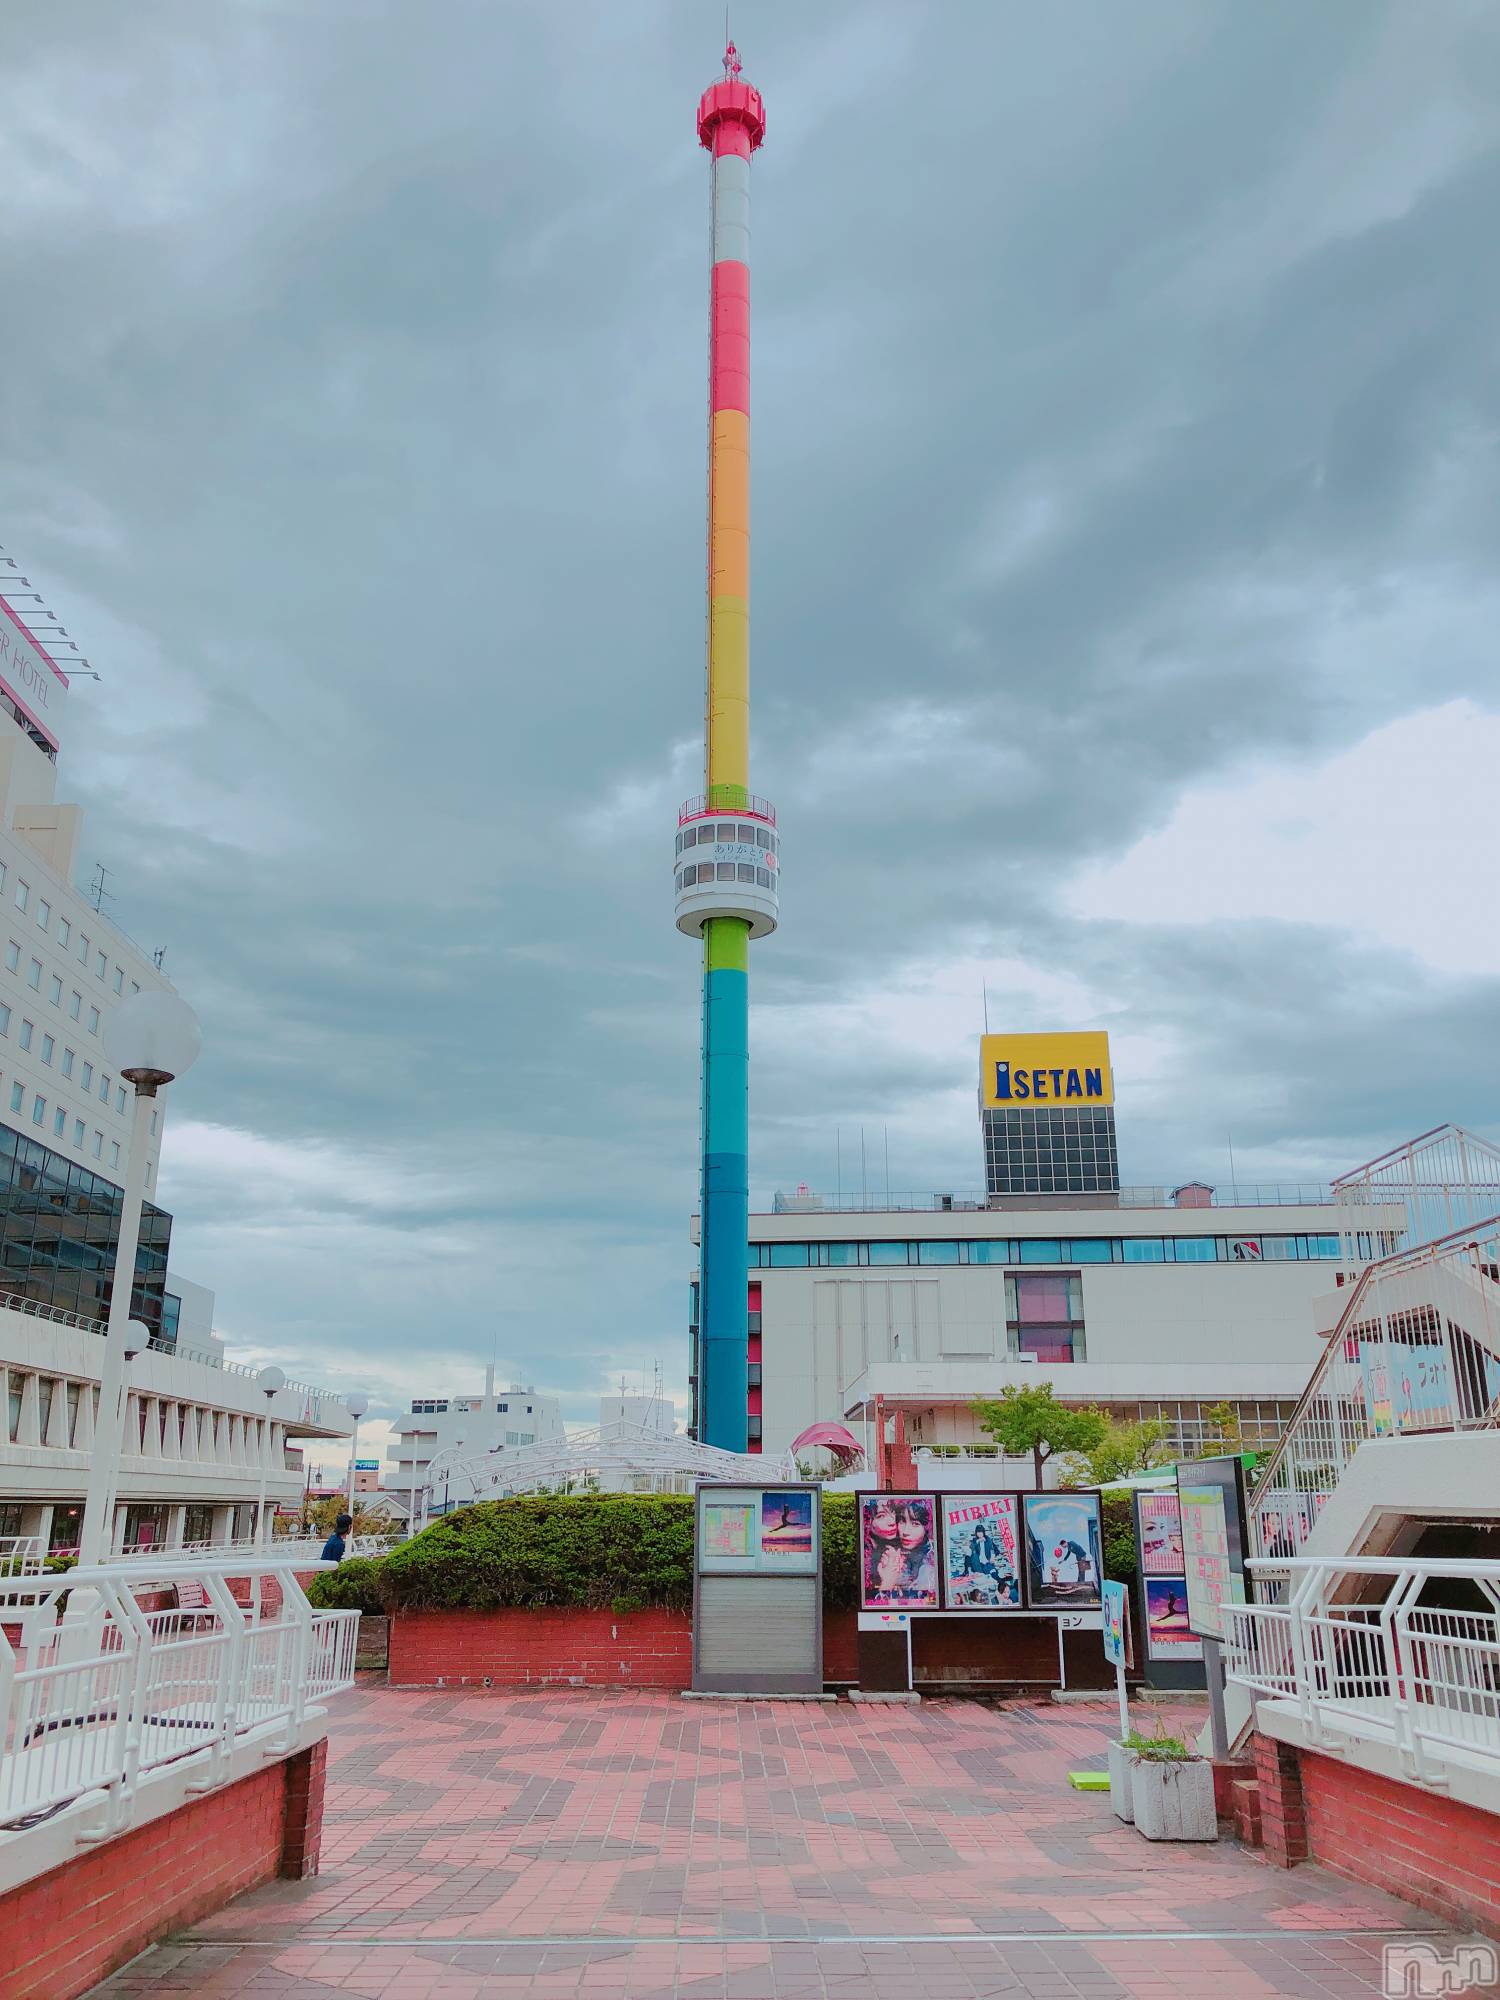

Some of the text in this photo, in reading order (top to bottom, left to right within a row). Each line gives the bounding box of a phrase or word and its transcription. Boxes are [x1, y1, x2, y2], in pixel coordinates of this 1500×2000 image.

[12, 647, 49, 709] HOTEL
[714, 843, 764, 859] ありがとう
[948, 1497, 1013, 1526] HIBIKI
